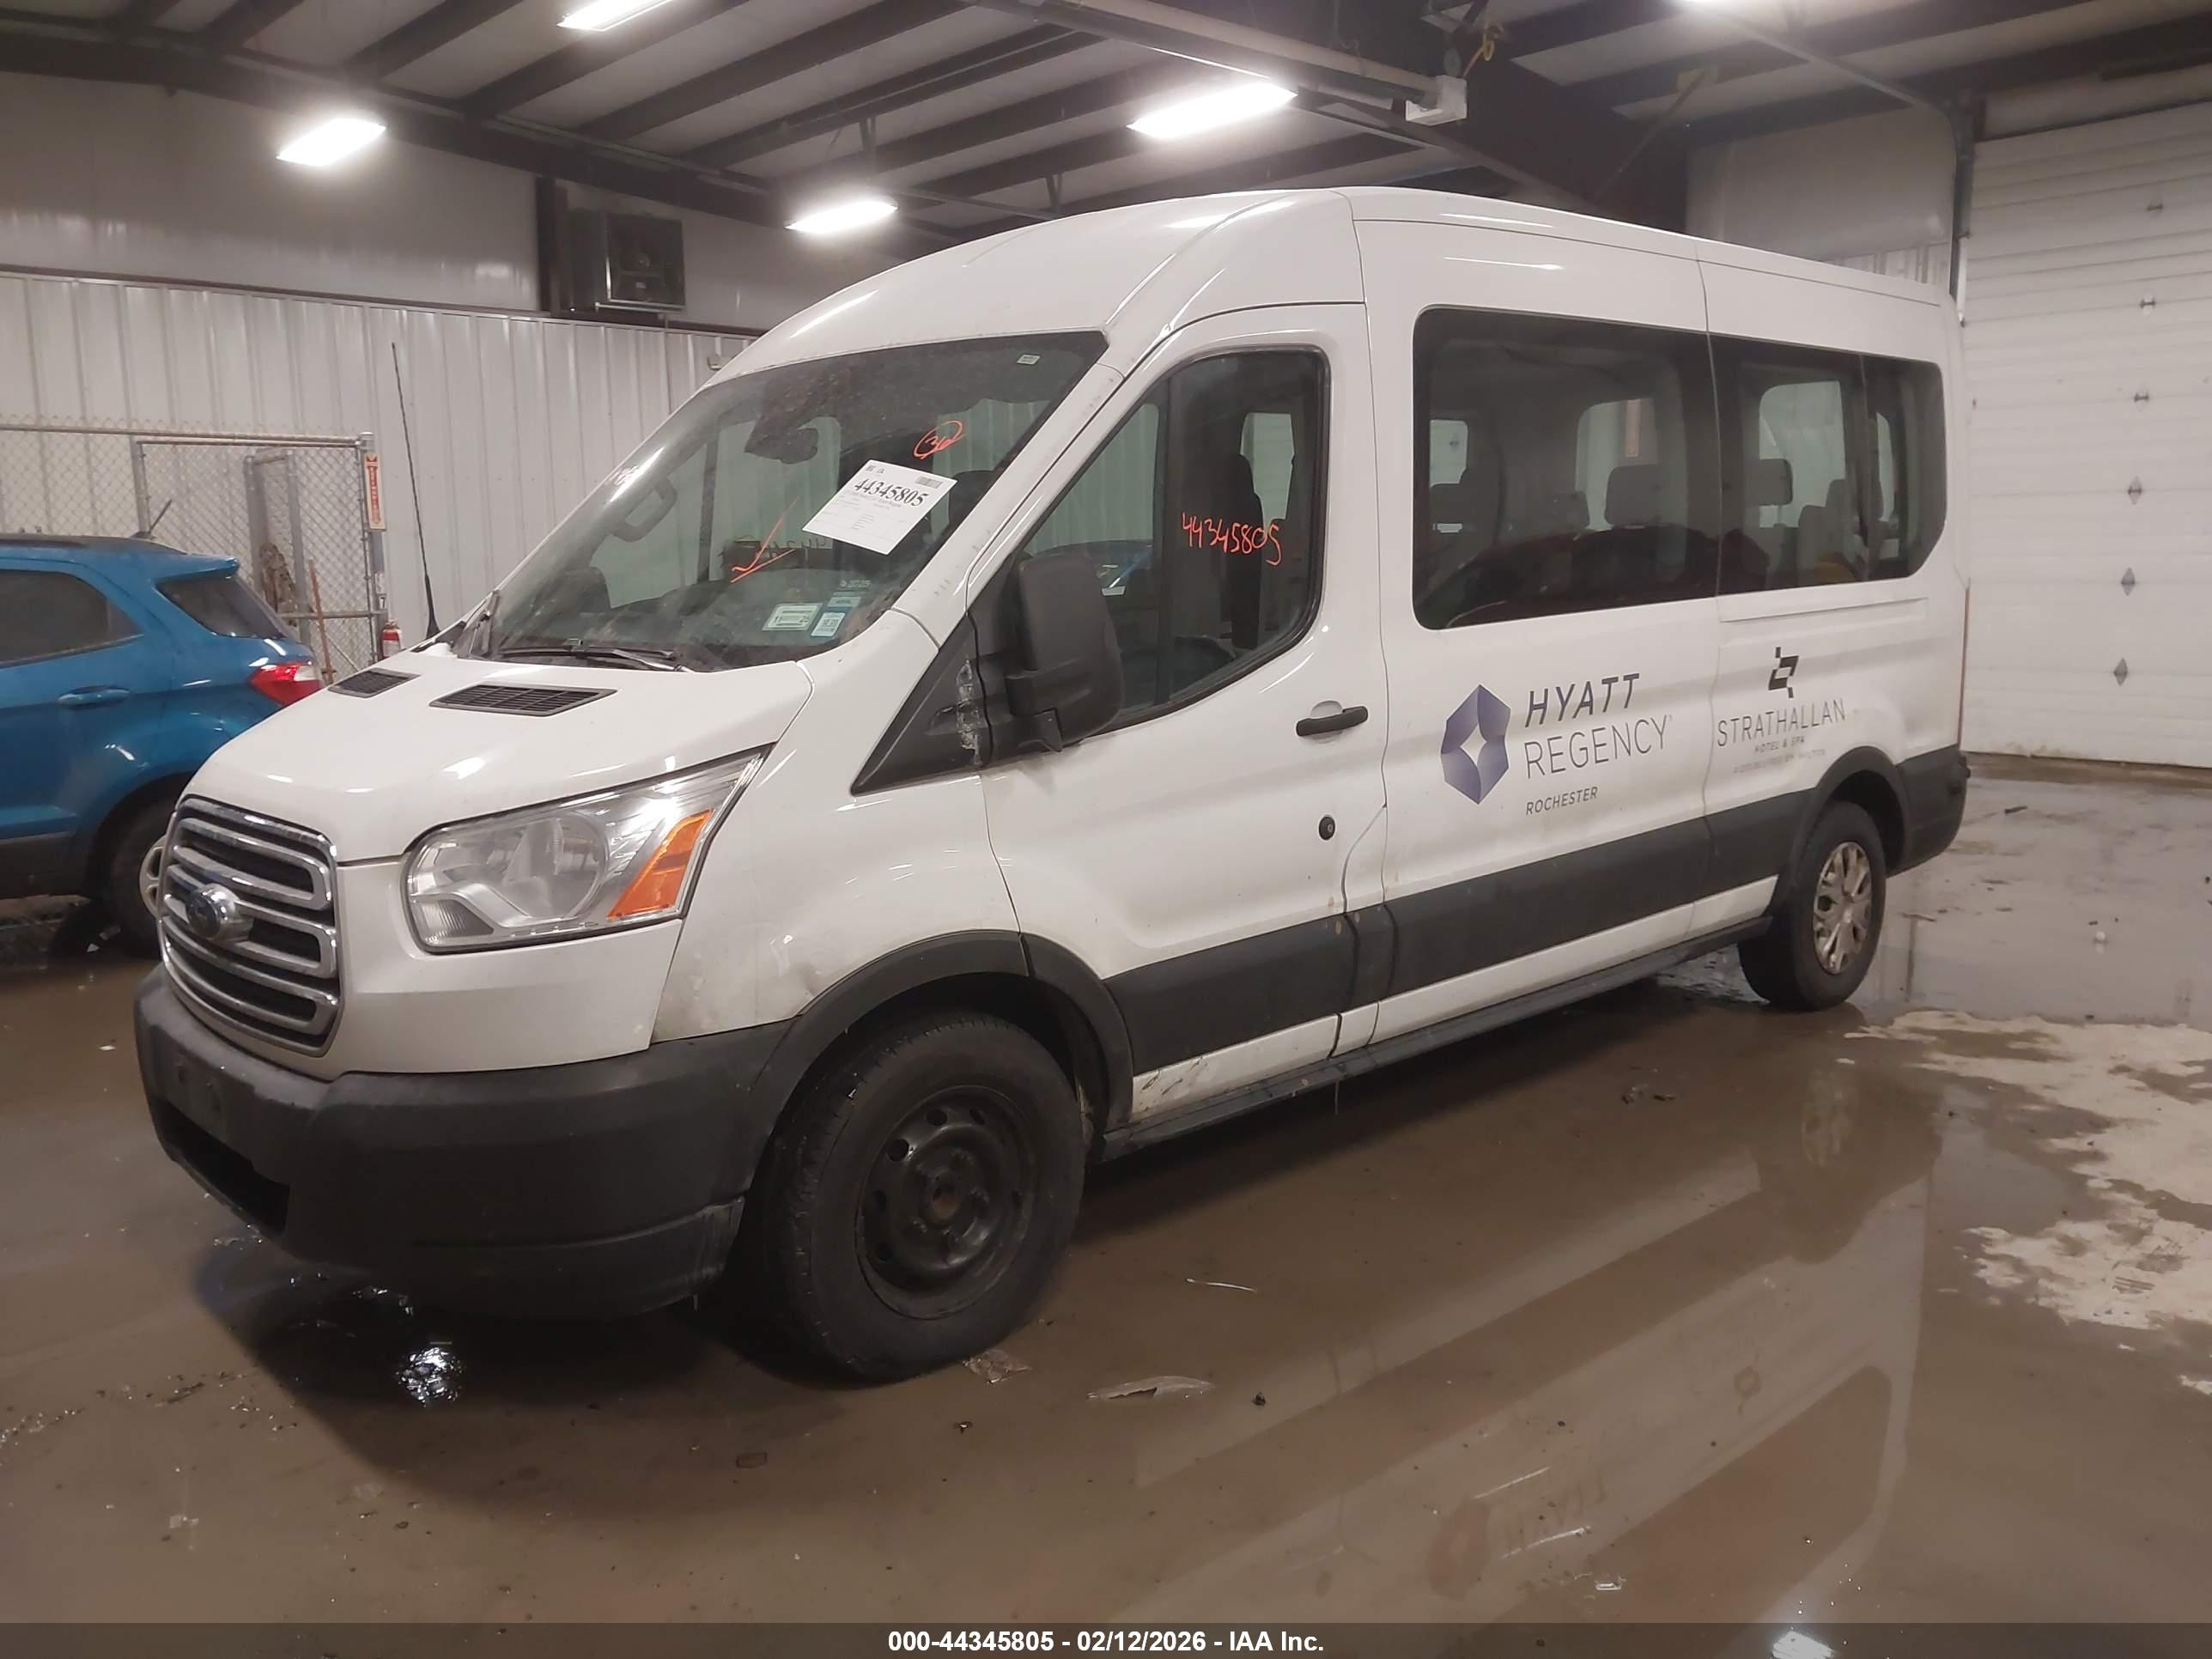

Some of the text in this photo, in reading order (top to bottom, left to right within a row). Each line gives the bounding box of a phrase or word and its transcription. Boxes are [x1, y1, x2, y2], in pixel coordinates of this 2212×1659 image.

[854, 478, 930, 507] 44345805
[1182, 512, 1282, 566] 44345805
[1525, 673, 1639, 728] HYATT
[1717, 698, 1846, 747] STRATHALLAN
[1524, 714, 1668, 779] REGENCY
[1526, 786, 1598, 816] ROCHESTER
